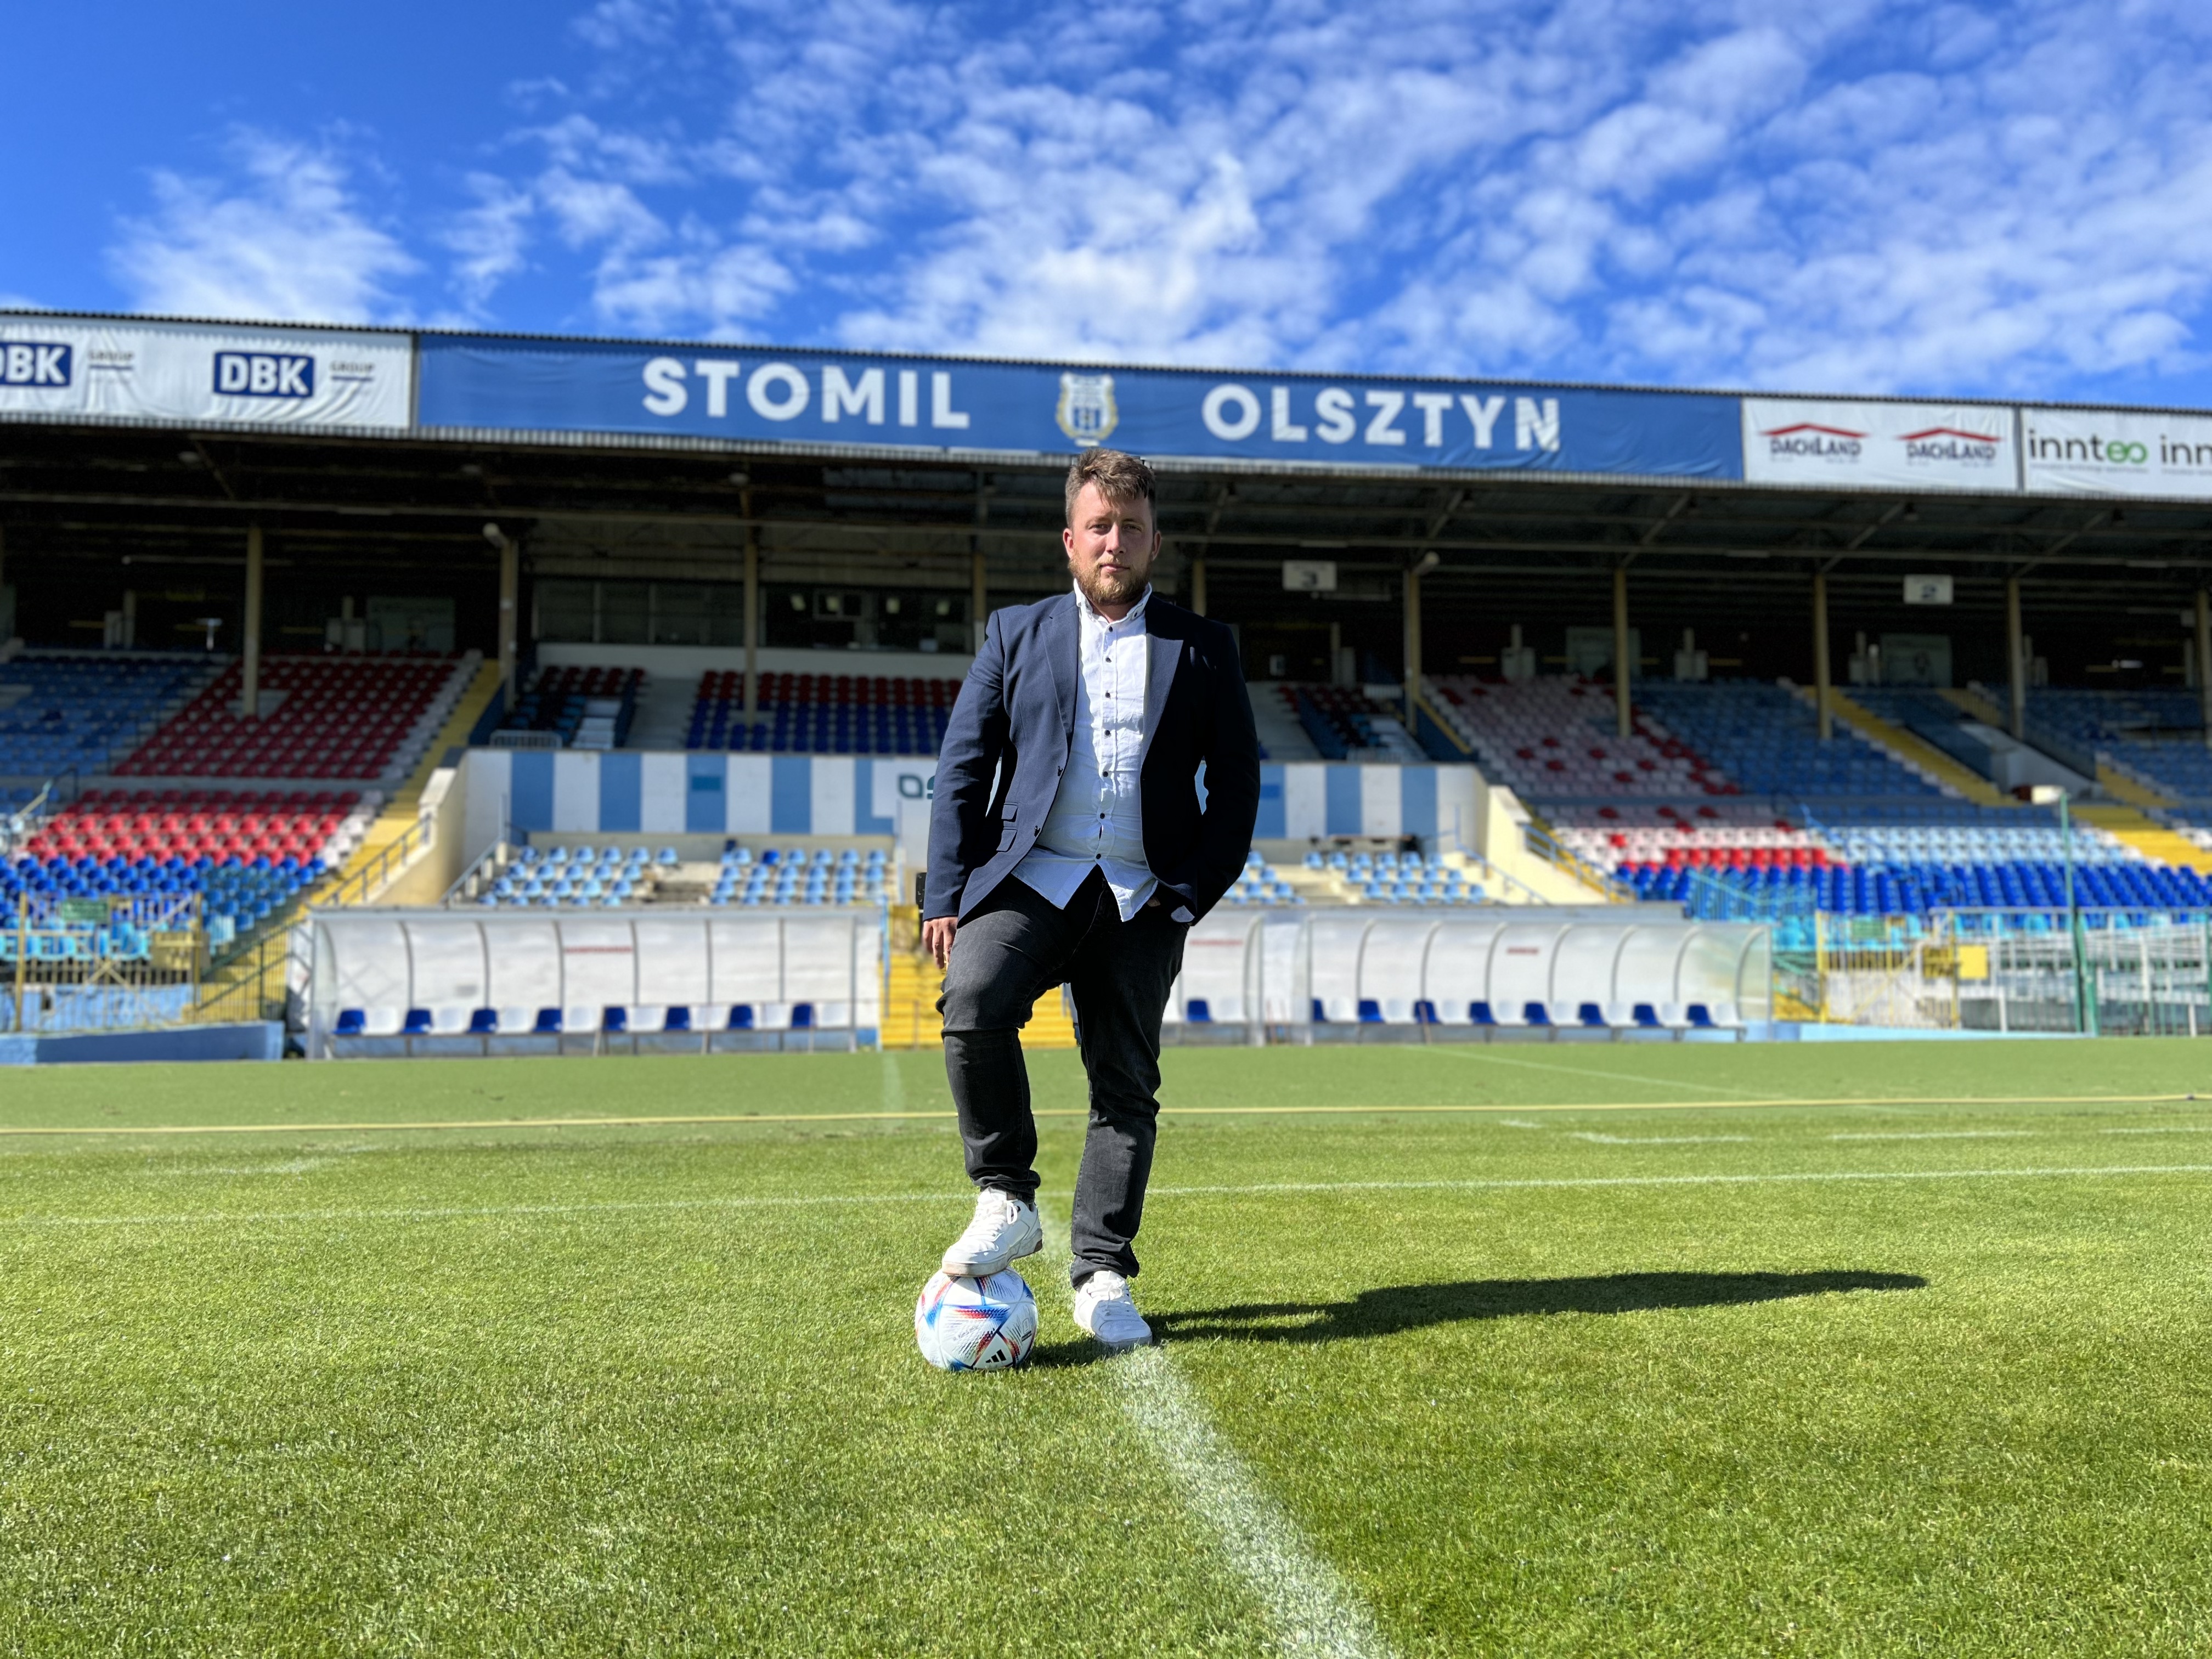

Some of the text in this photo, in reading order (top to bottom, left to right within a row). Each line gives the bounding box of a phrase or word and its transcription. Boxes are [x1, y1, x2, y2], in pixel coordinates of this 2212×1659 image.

[0, 345, 65, 383] BK
[220, 356, 309, 395] DBK
[642, 357, 1560, 452] STOMIL OLSZTYN
